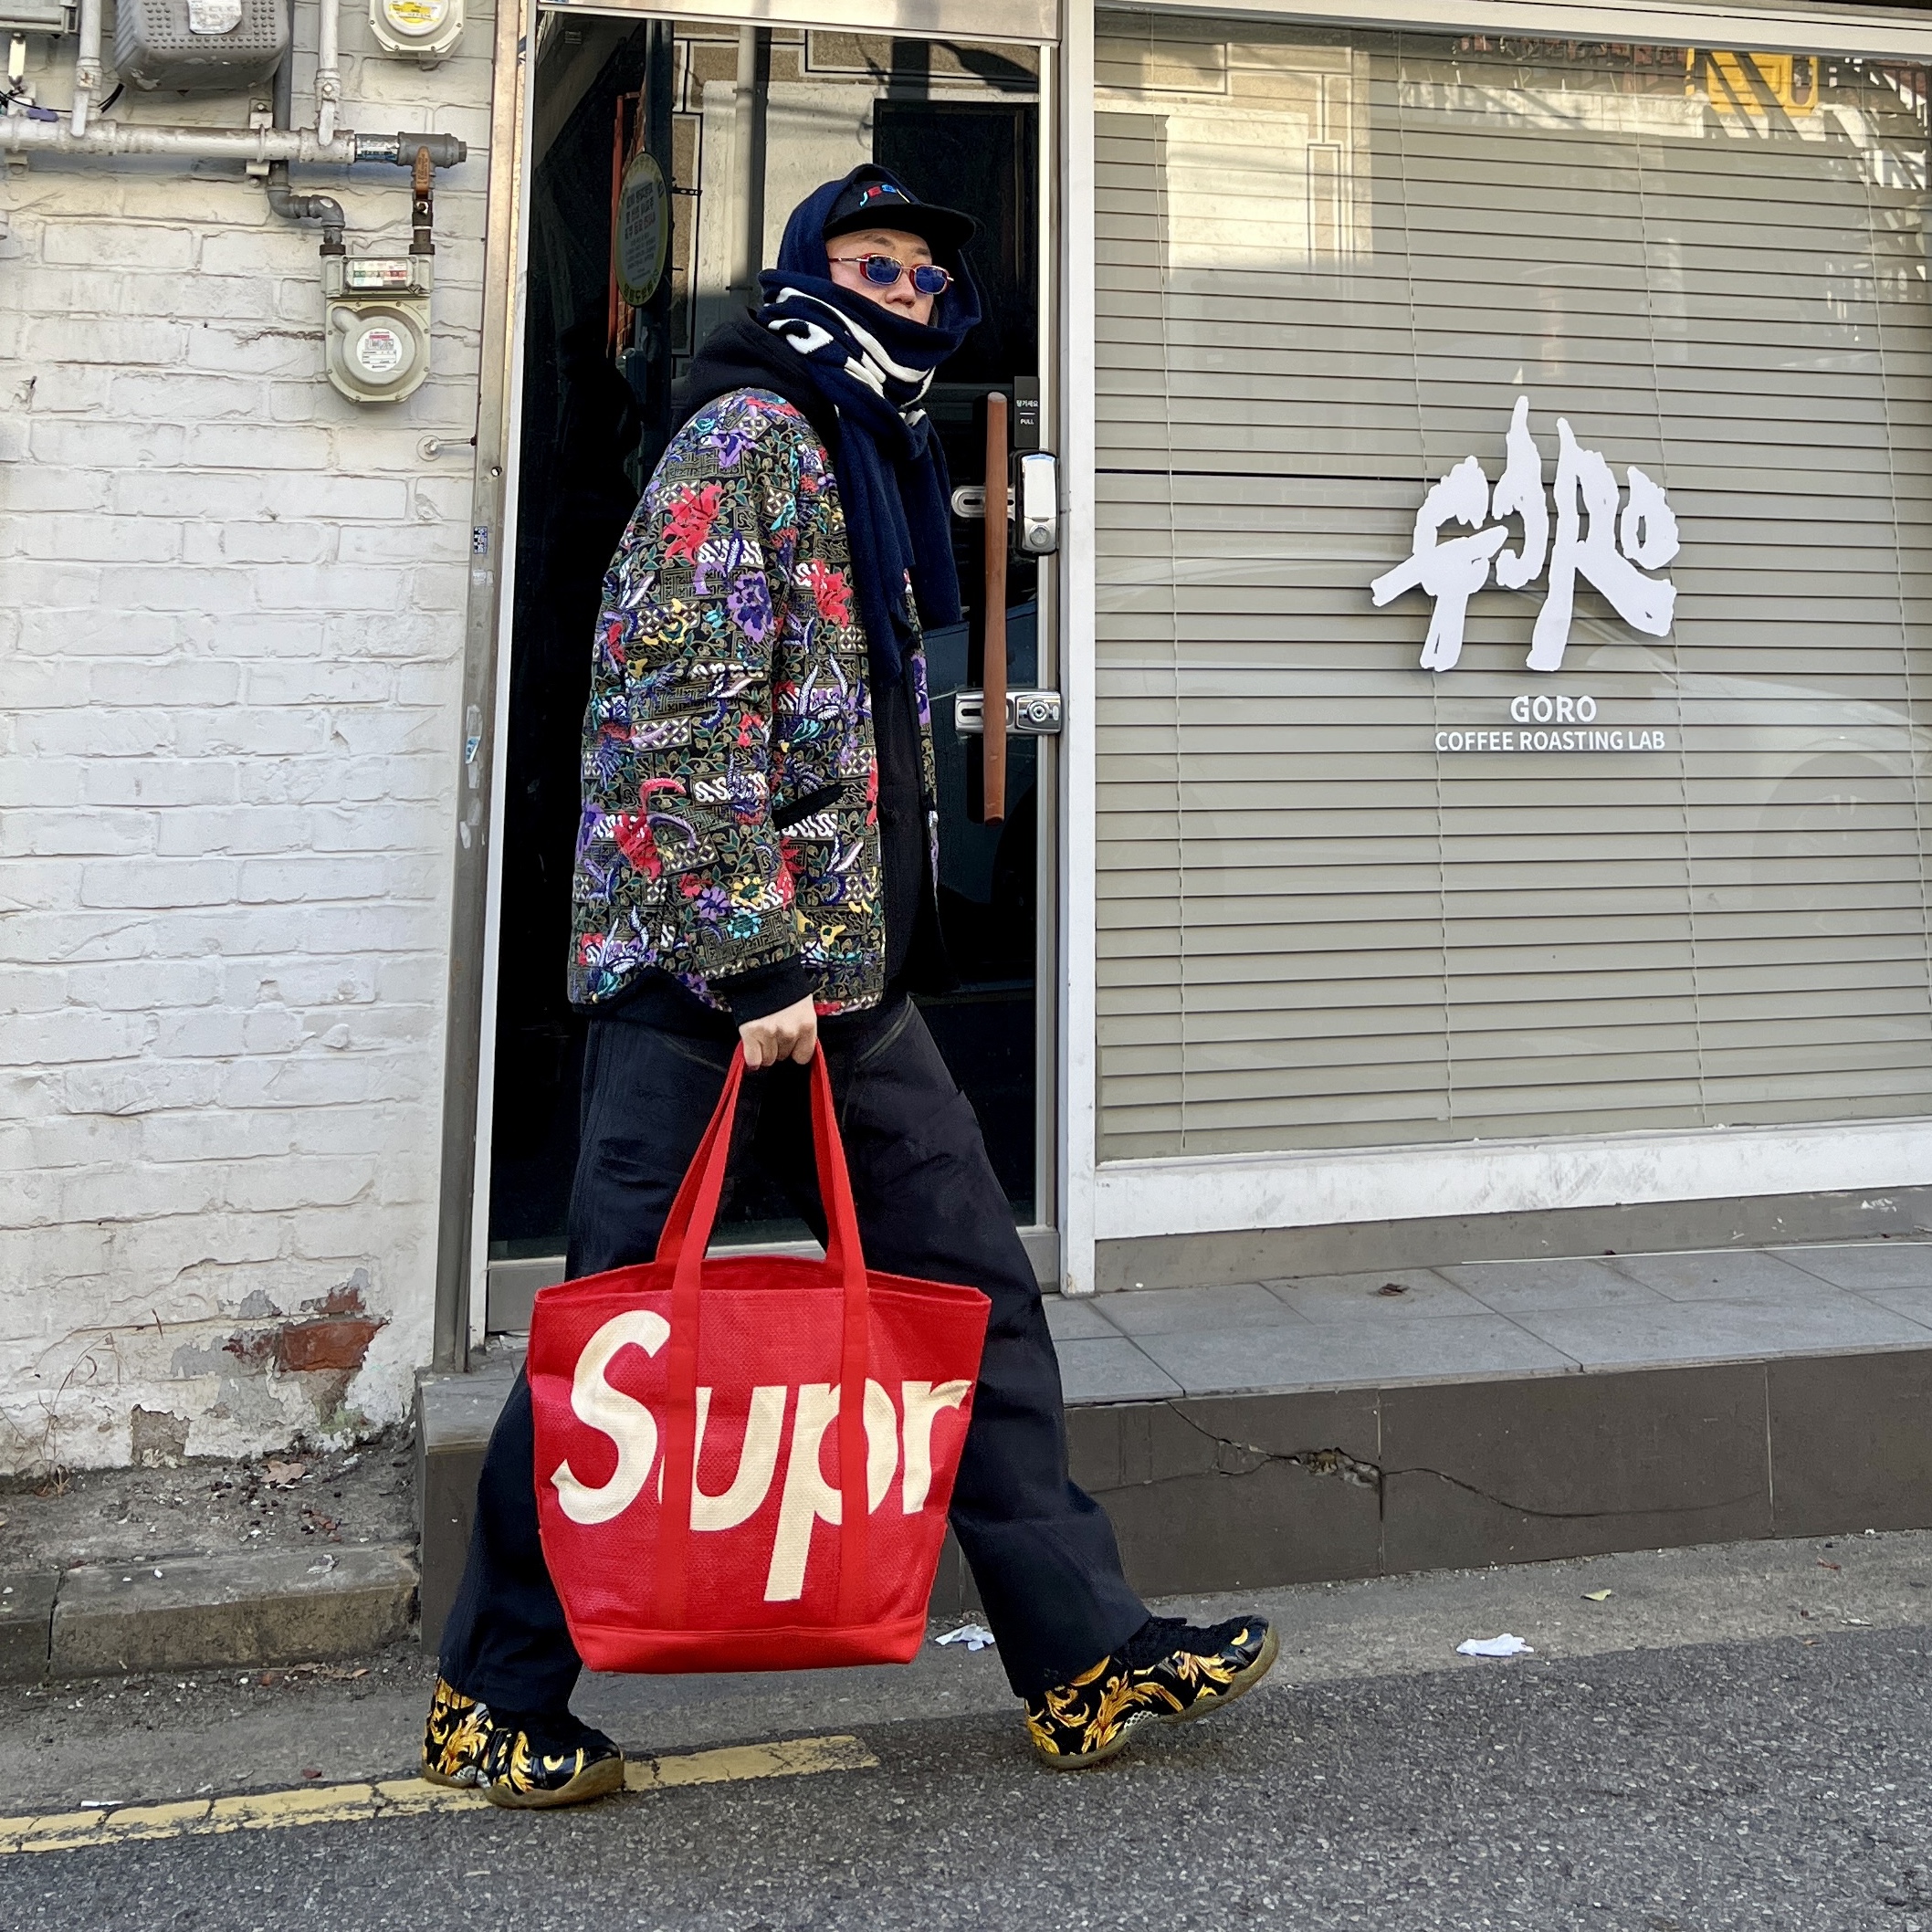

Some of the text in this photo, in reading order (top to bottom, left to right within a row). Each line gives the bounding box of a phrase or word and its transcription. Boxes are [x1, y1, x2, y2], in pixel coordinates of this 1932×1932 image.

[1510, 695, 1597, 723] GORO
[1434, 730, 1665, 751] COFFEE ROASTING LAB
